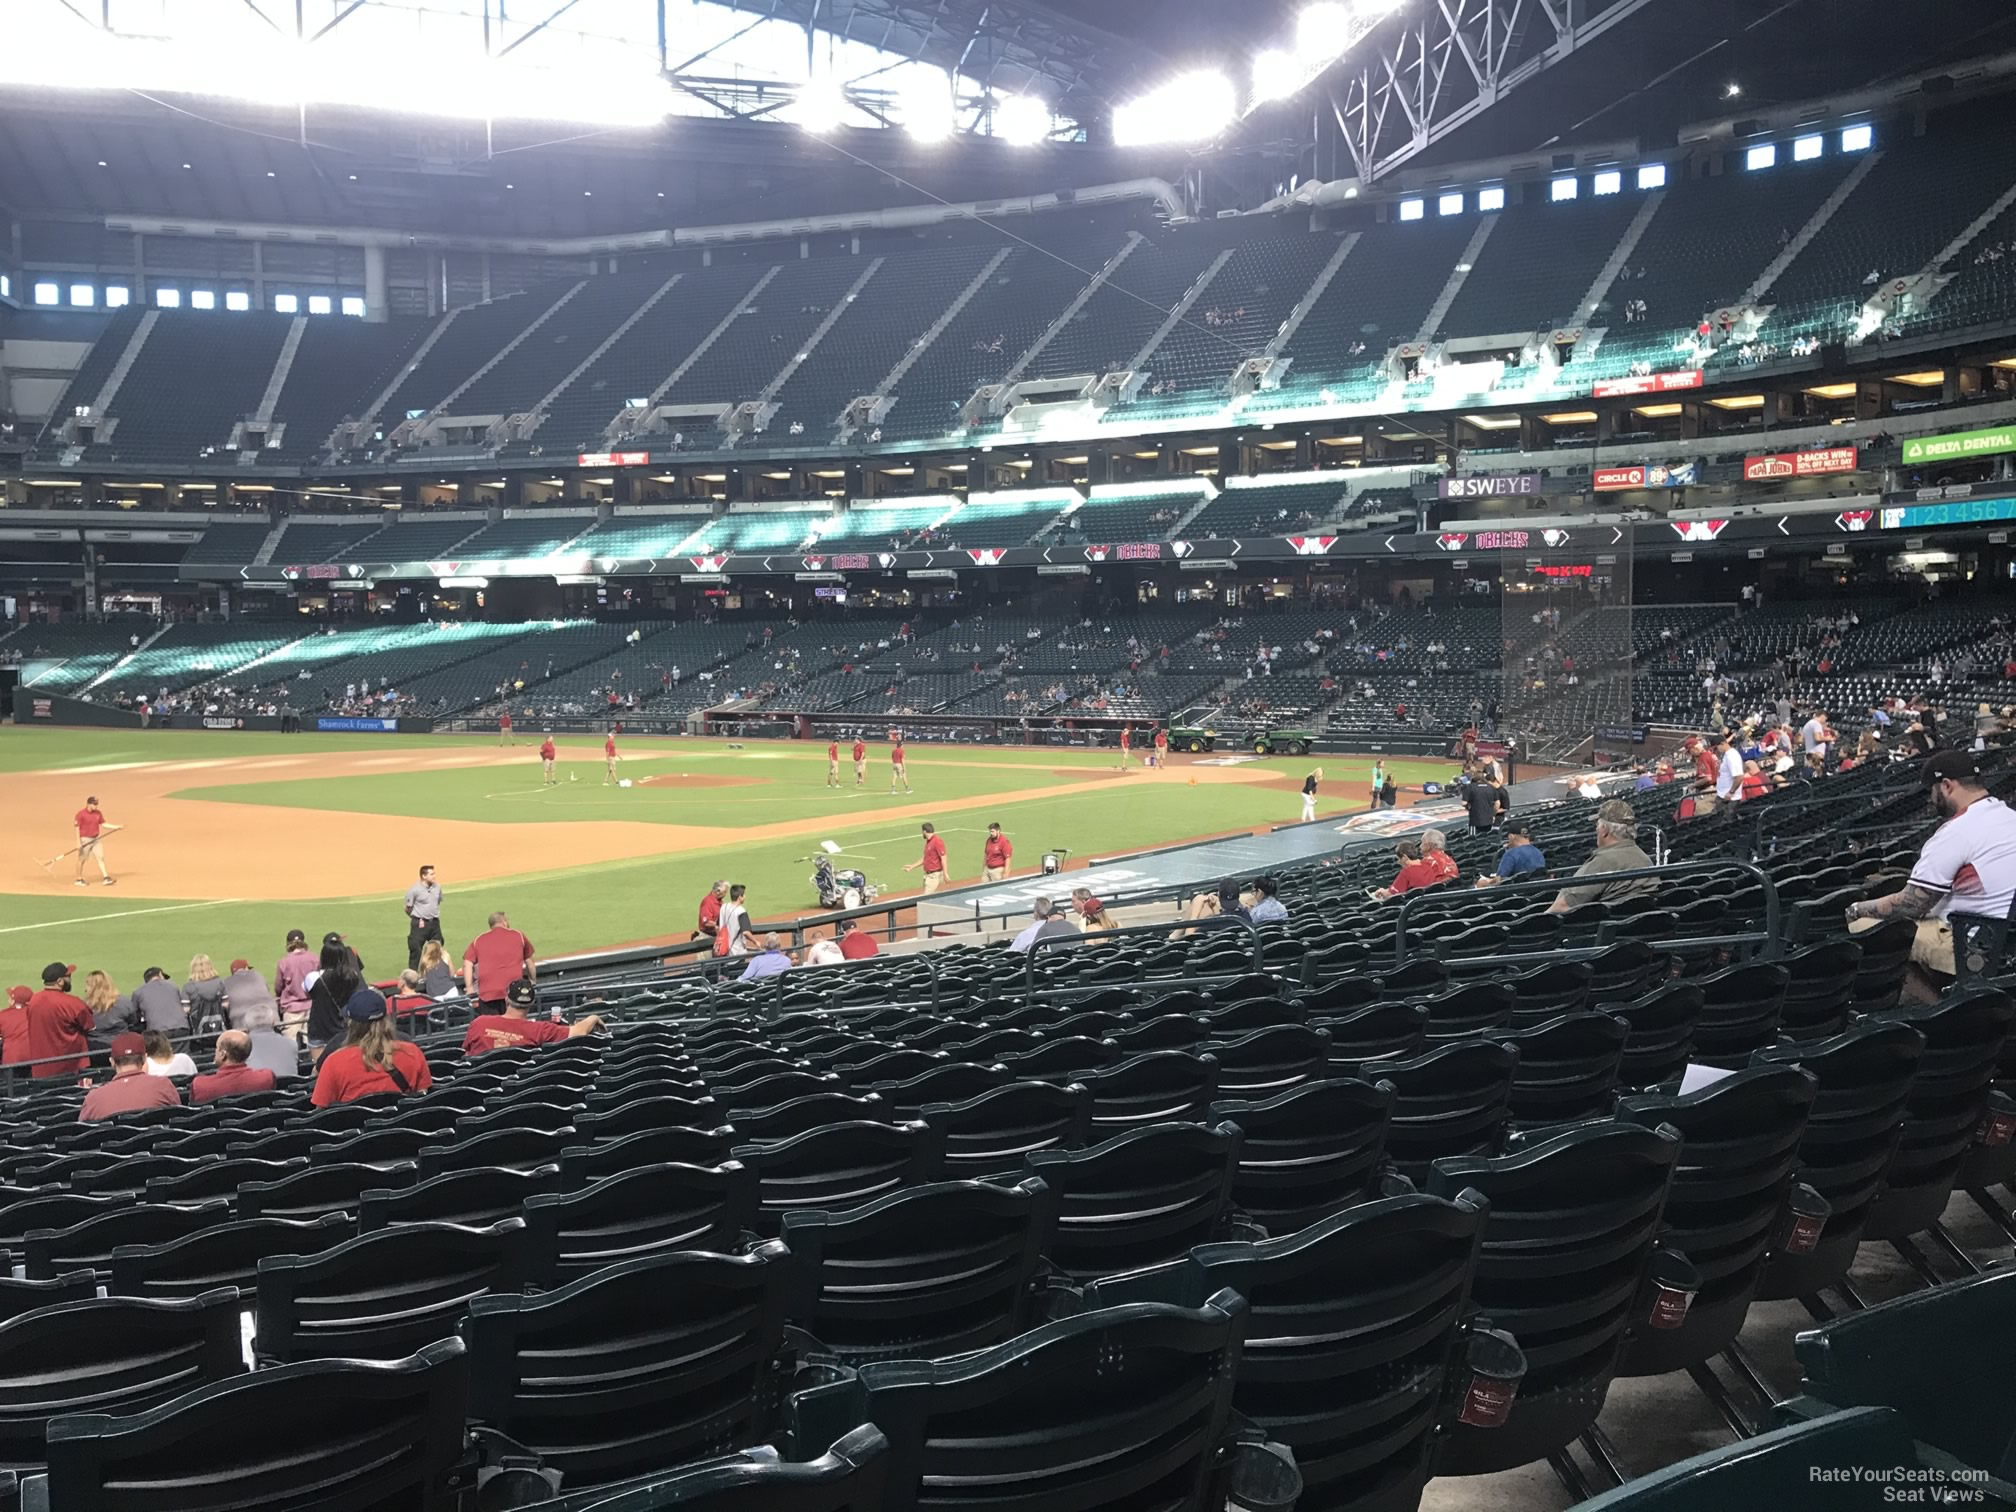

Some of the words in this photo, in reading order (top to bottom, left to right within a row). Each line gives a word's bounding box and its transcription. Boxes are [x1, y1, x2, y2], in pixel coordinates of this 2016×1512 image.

[1926, 442, 1961, 455] DELTA
[1963, 434, 2012, 450] DENTAL
[1797, 452, 1829, 463] D-BACKS
[1824, 459, 1839, 467] NEXT
[1750, 464, 1767, 476] PAPA
[1598, 474, 1627, 483] CIRCLE
[1629, 470, 1641, 483] K
[319, 719, 355, 728] Shamrock
